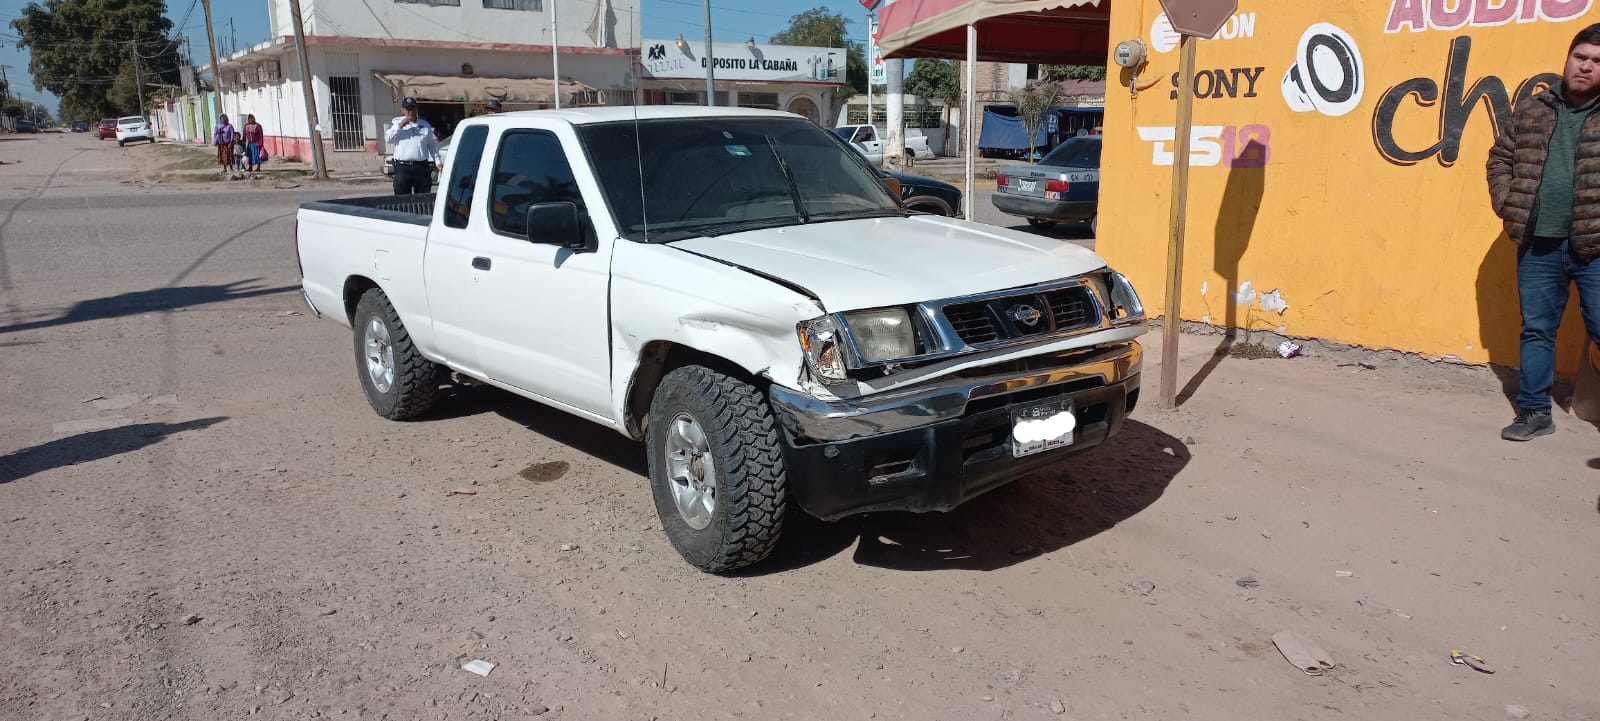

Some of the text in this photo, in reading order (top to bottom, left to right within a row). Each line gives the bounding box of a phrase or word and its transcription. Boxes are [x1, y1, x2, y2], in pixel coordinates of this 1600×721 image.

[701, 57, 746, 70] DPOSITO
[749, 58, 759, 70] LA
[762, 57, 798, 72] CABAÑA
